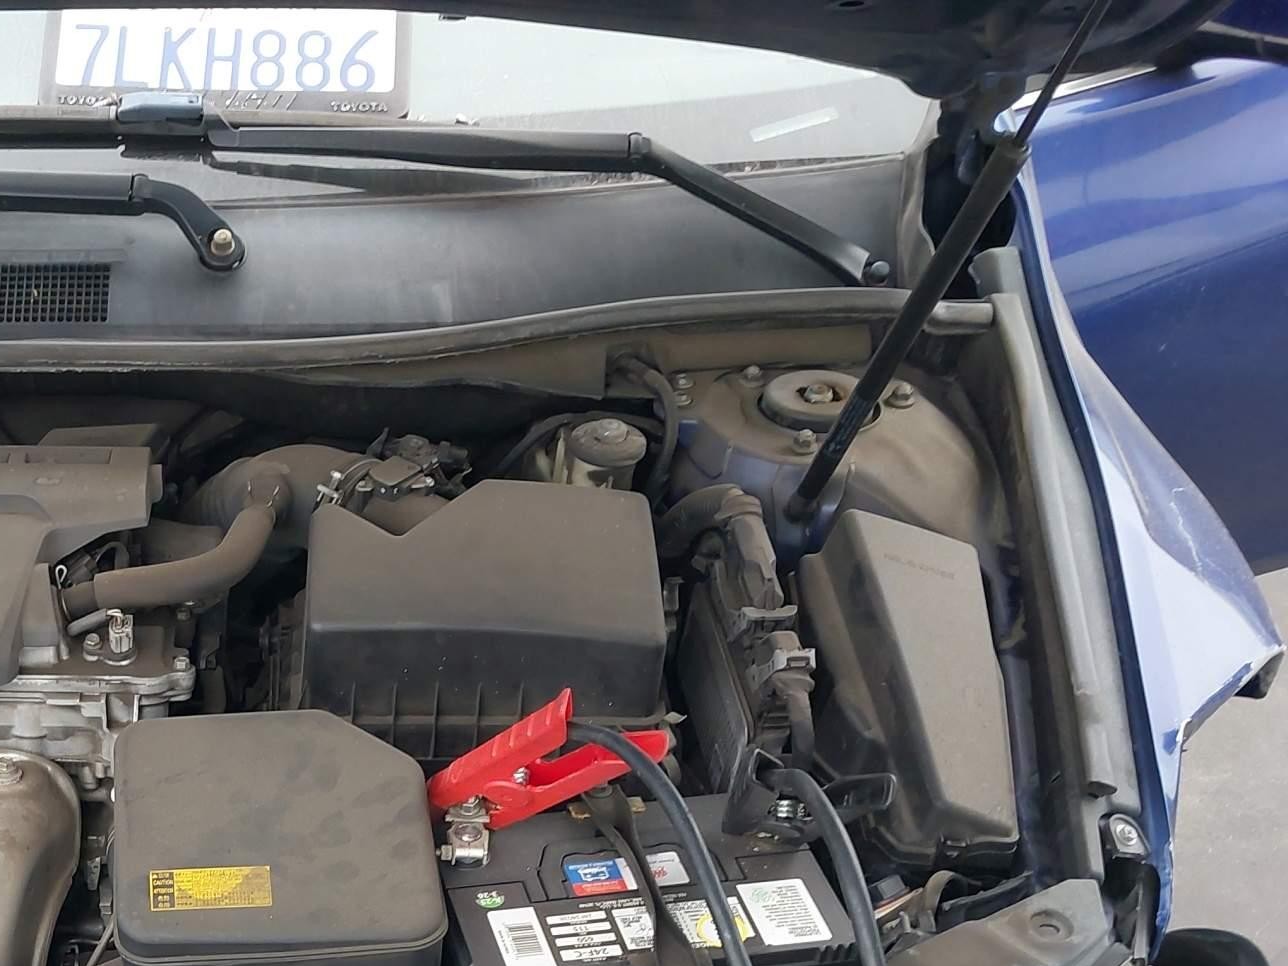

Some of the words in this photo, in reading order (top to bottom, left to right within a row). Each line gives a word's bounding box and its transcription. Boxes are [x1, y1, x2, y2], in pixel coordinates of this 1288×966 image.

[75, 23, 379, 92] 7LKH886
[330, 101, 389, 113] TOYOTA
[573, 947, 609, 959] 24F-C
